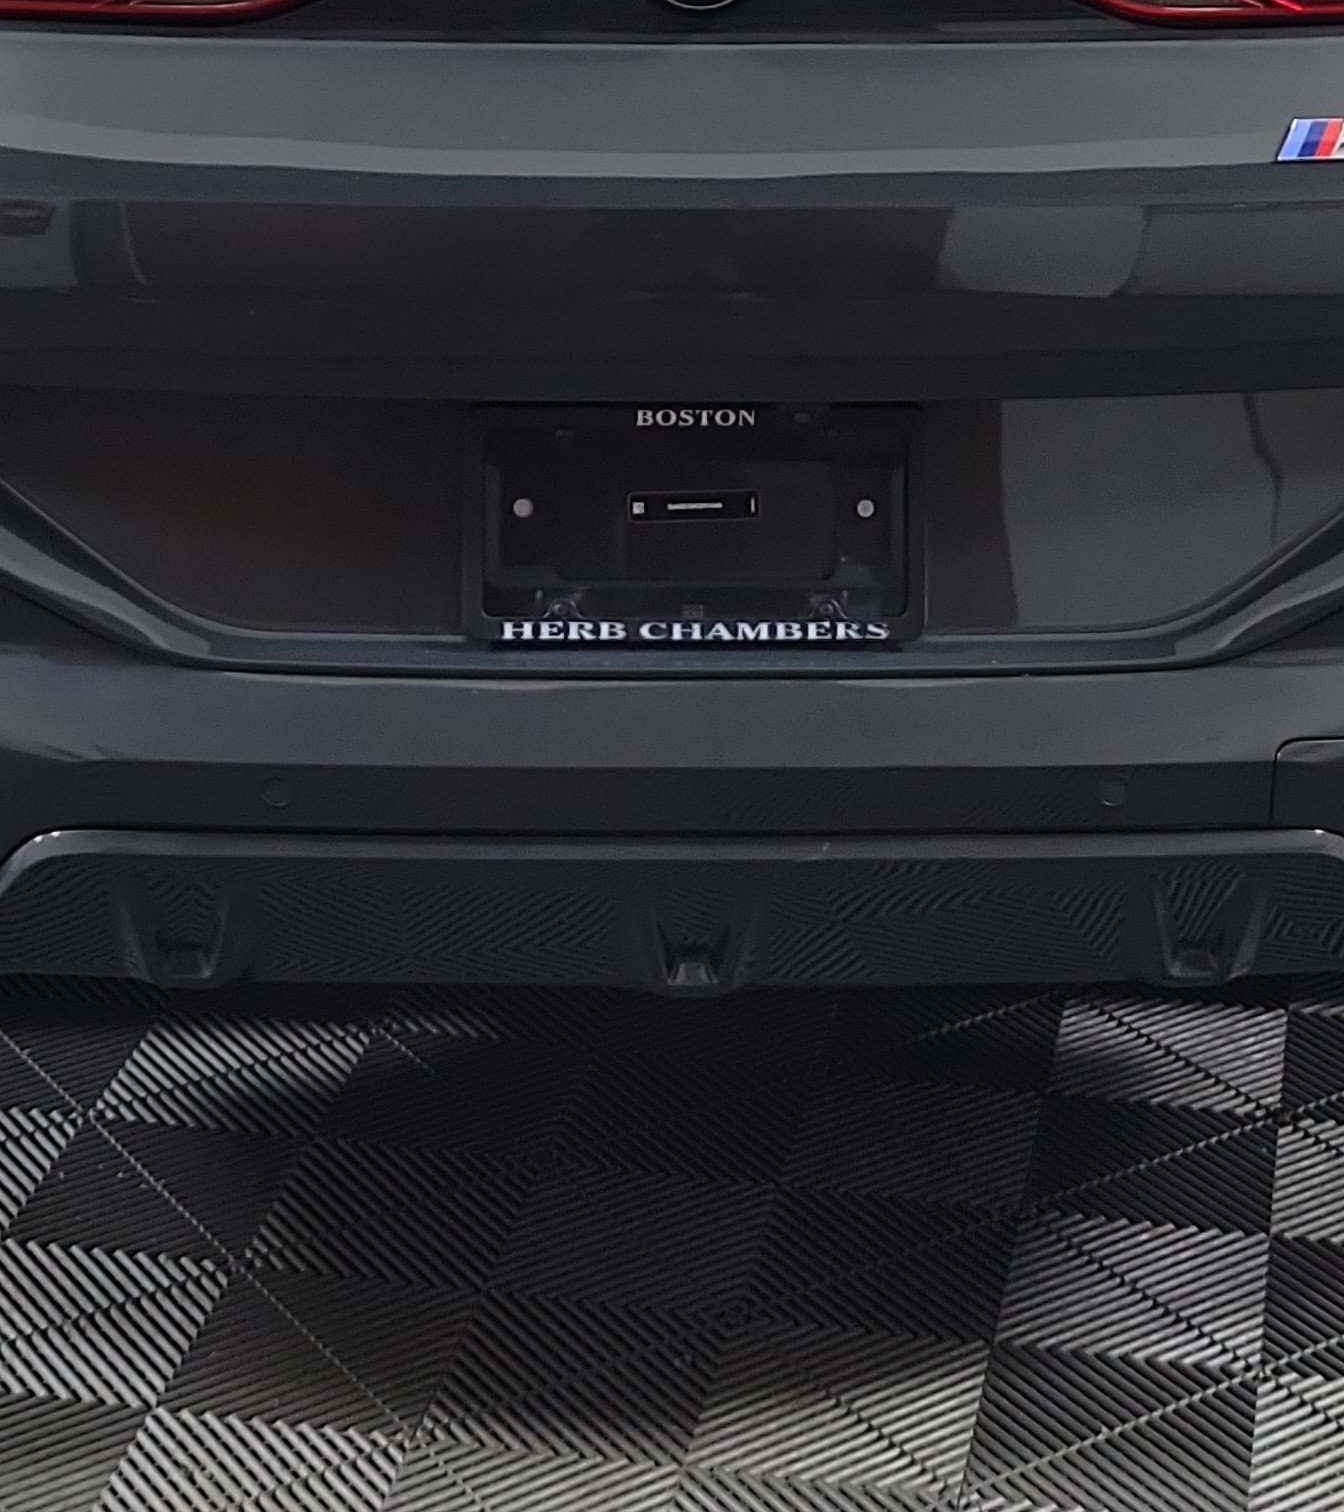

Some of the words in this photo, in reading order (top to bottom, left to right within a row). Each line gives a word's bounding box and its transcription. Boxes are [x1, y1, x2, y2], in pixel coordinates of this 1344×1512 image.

[636, 409, 756, 427] BOSTON
[501, 620, 627, 642] HERB
[639, 620, 890, 642] CHAMBERS
